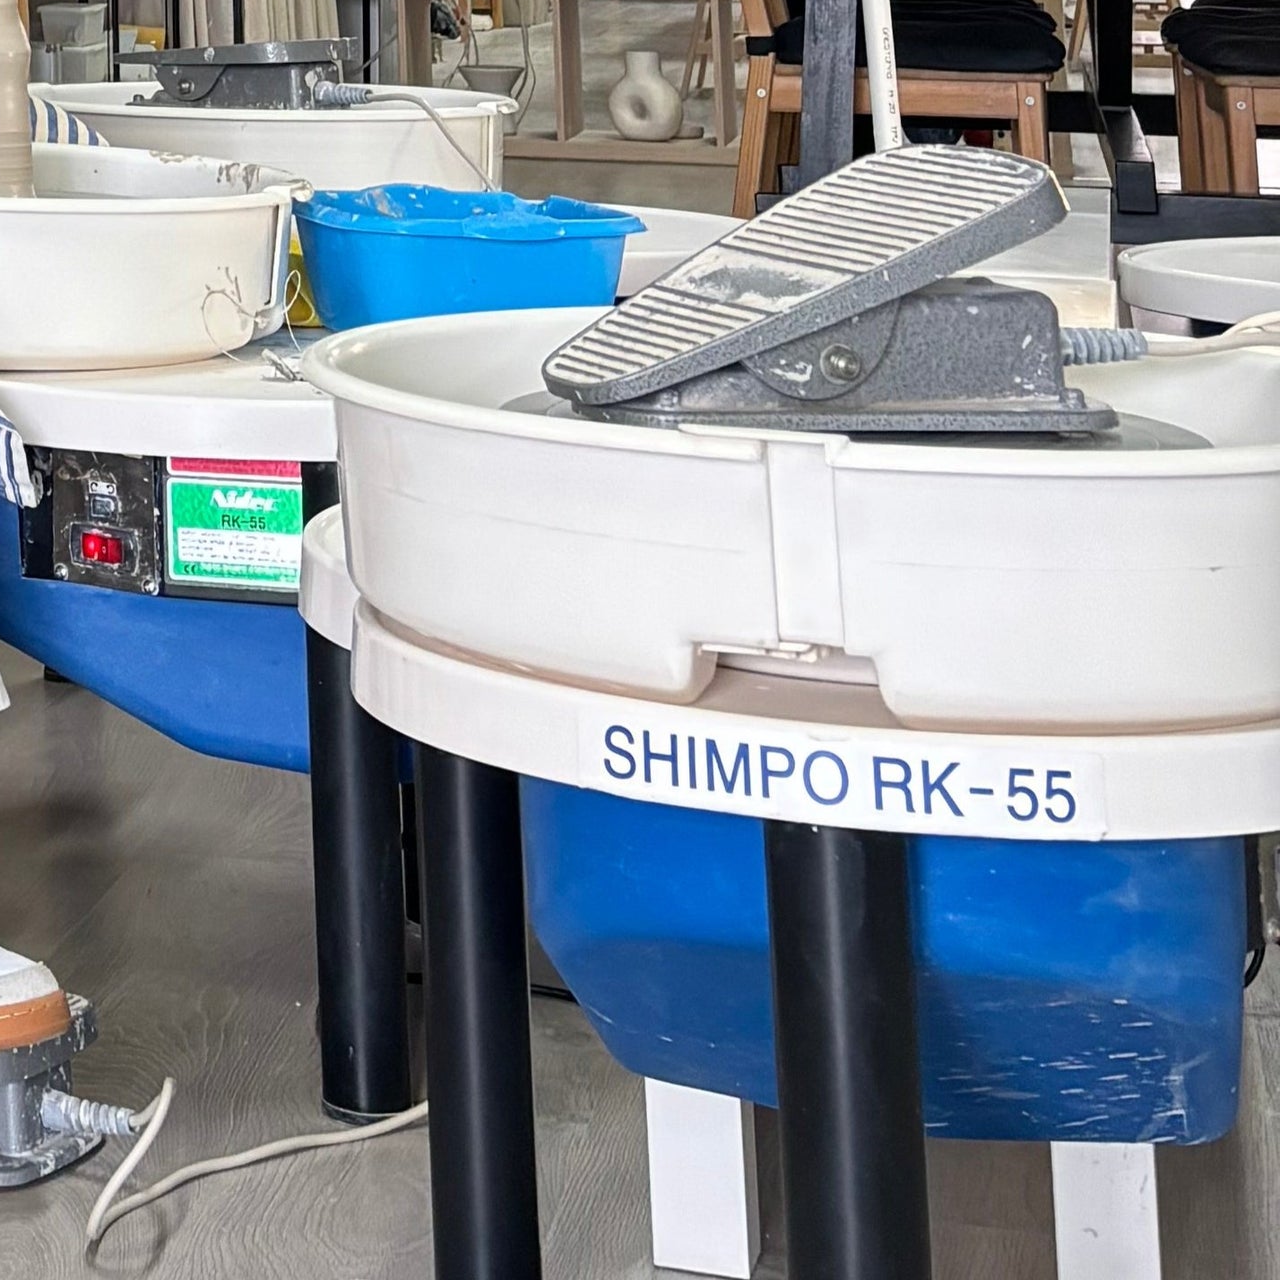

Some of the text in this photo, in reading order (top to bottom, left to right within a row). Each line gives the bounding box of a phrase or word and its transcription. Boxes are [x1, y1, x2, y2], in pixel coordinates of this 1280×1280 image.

[220, 513, 267, 531] RK-55
[603, 724, 1077, 823] SHIMPO RK-55
